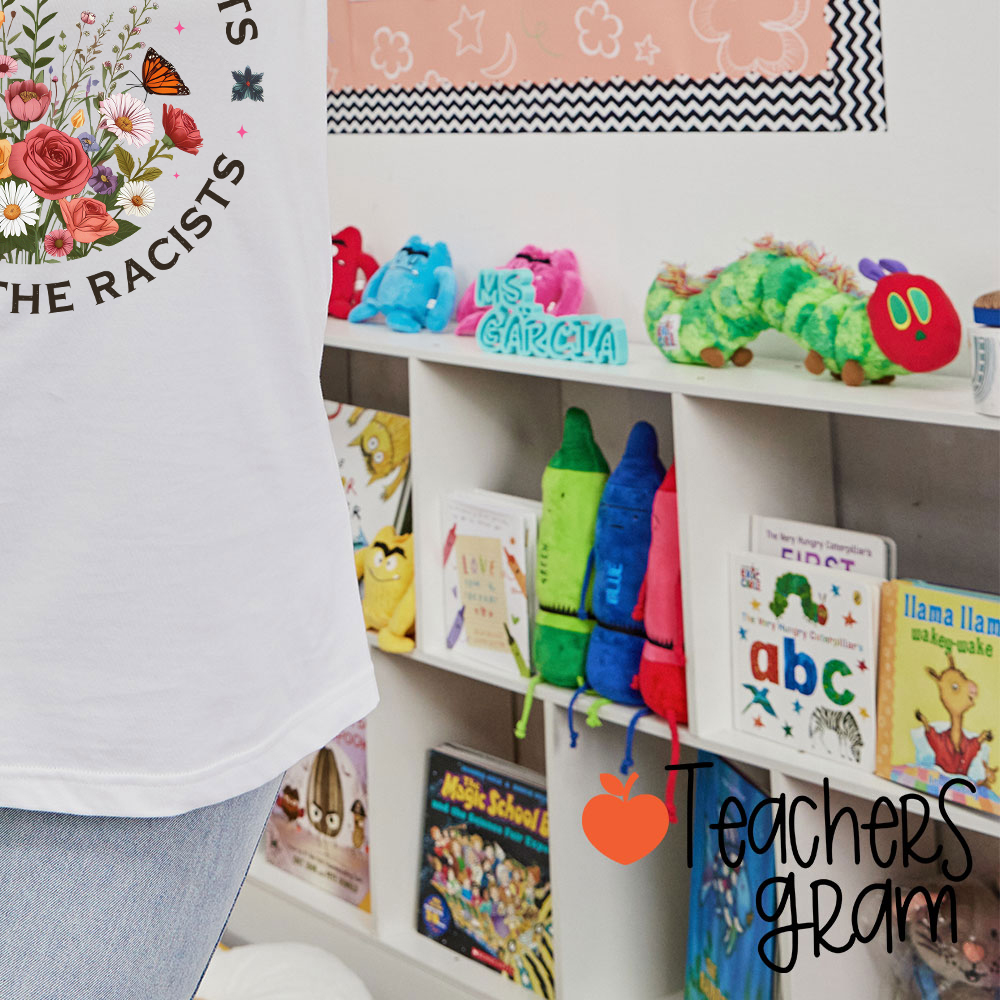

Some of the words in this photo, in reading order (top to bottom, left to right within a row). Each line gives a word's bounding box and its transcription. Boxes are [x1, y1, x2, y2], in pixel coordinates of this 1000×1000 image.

[86, 151, 246, 307] RACISTS
[476, 269, 530, 306] MS
[477, 314, 622, 366] GARCIA
[904, 593, 954, 628] llama
[961, 604, 1000, 638] llam
[750, 636, 855, 706] abc
[440, 772, 487, 811] Magic
[487, 788, 541, 833] School
[539, 809, 549, 838] B
